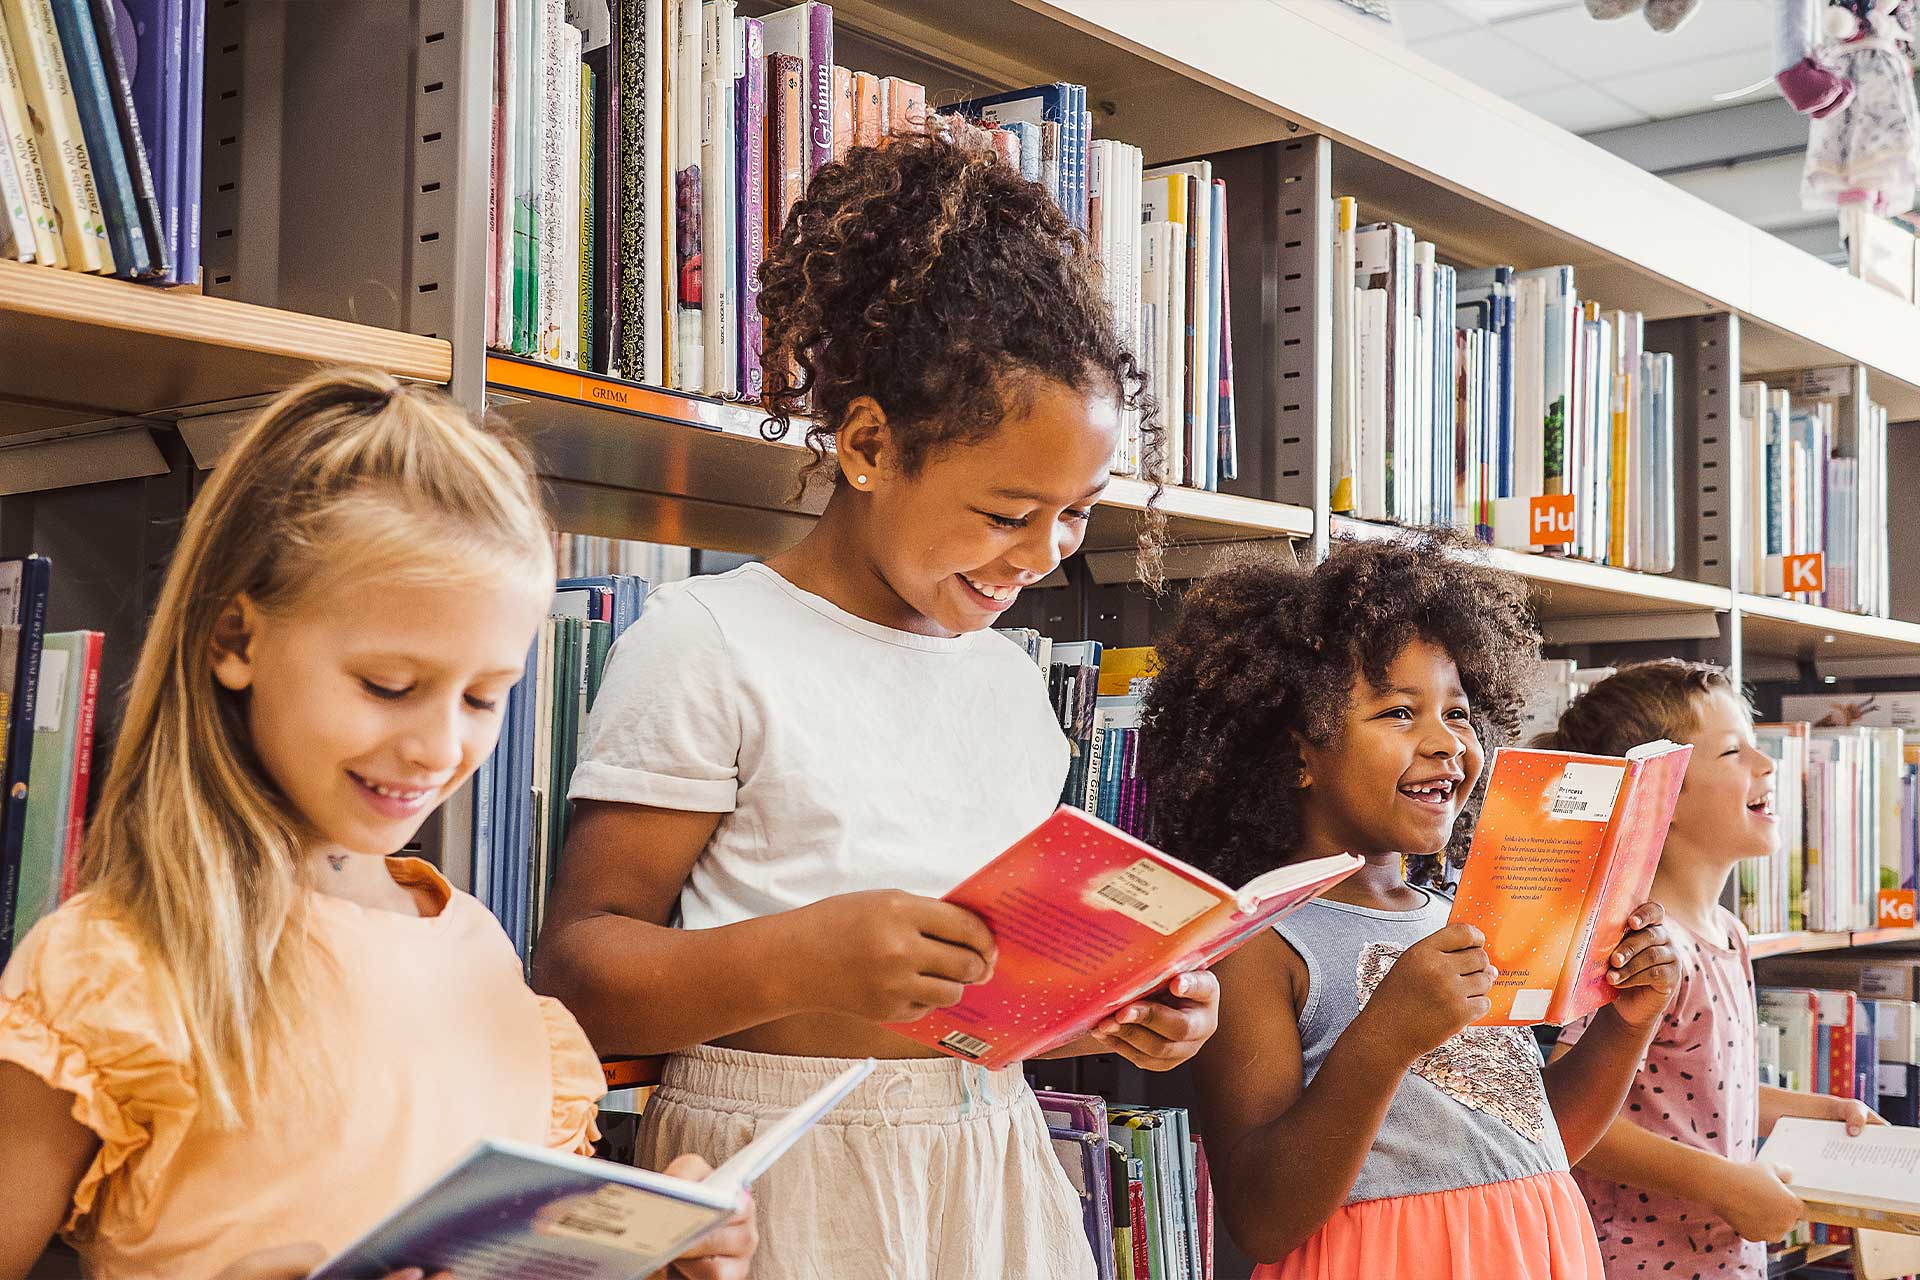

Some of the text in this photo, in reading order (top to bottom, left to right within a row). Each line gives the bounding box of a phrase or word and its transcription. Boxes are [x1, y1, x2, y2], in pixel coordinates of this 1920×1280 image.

[813, 64, 832, 149] Grimm
[84, 173, 100, 214] Založba
[581, 207, 589, 247] Grimm
[581, 249, 589, 296] Wilhelm
[581, 308, 589, 341] Jacob
[592, 386, 628, 404] GRIMM
[1534, 506, 1574, 533] Hu
[1791, 559, 1815, 586] K
[1087, 727, 1104, 814] Bogdan Grom
[1880, 899, 1912, 920] Ke
